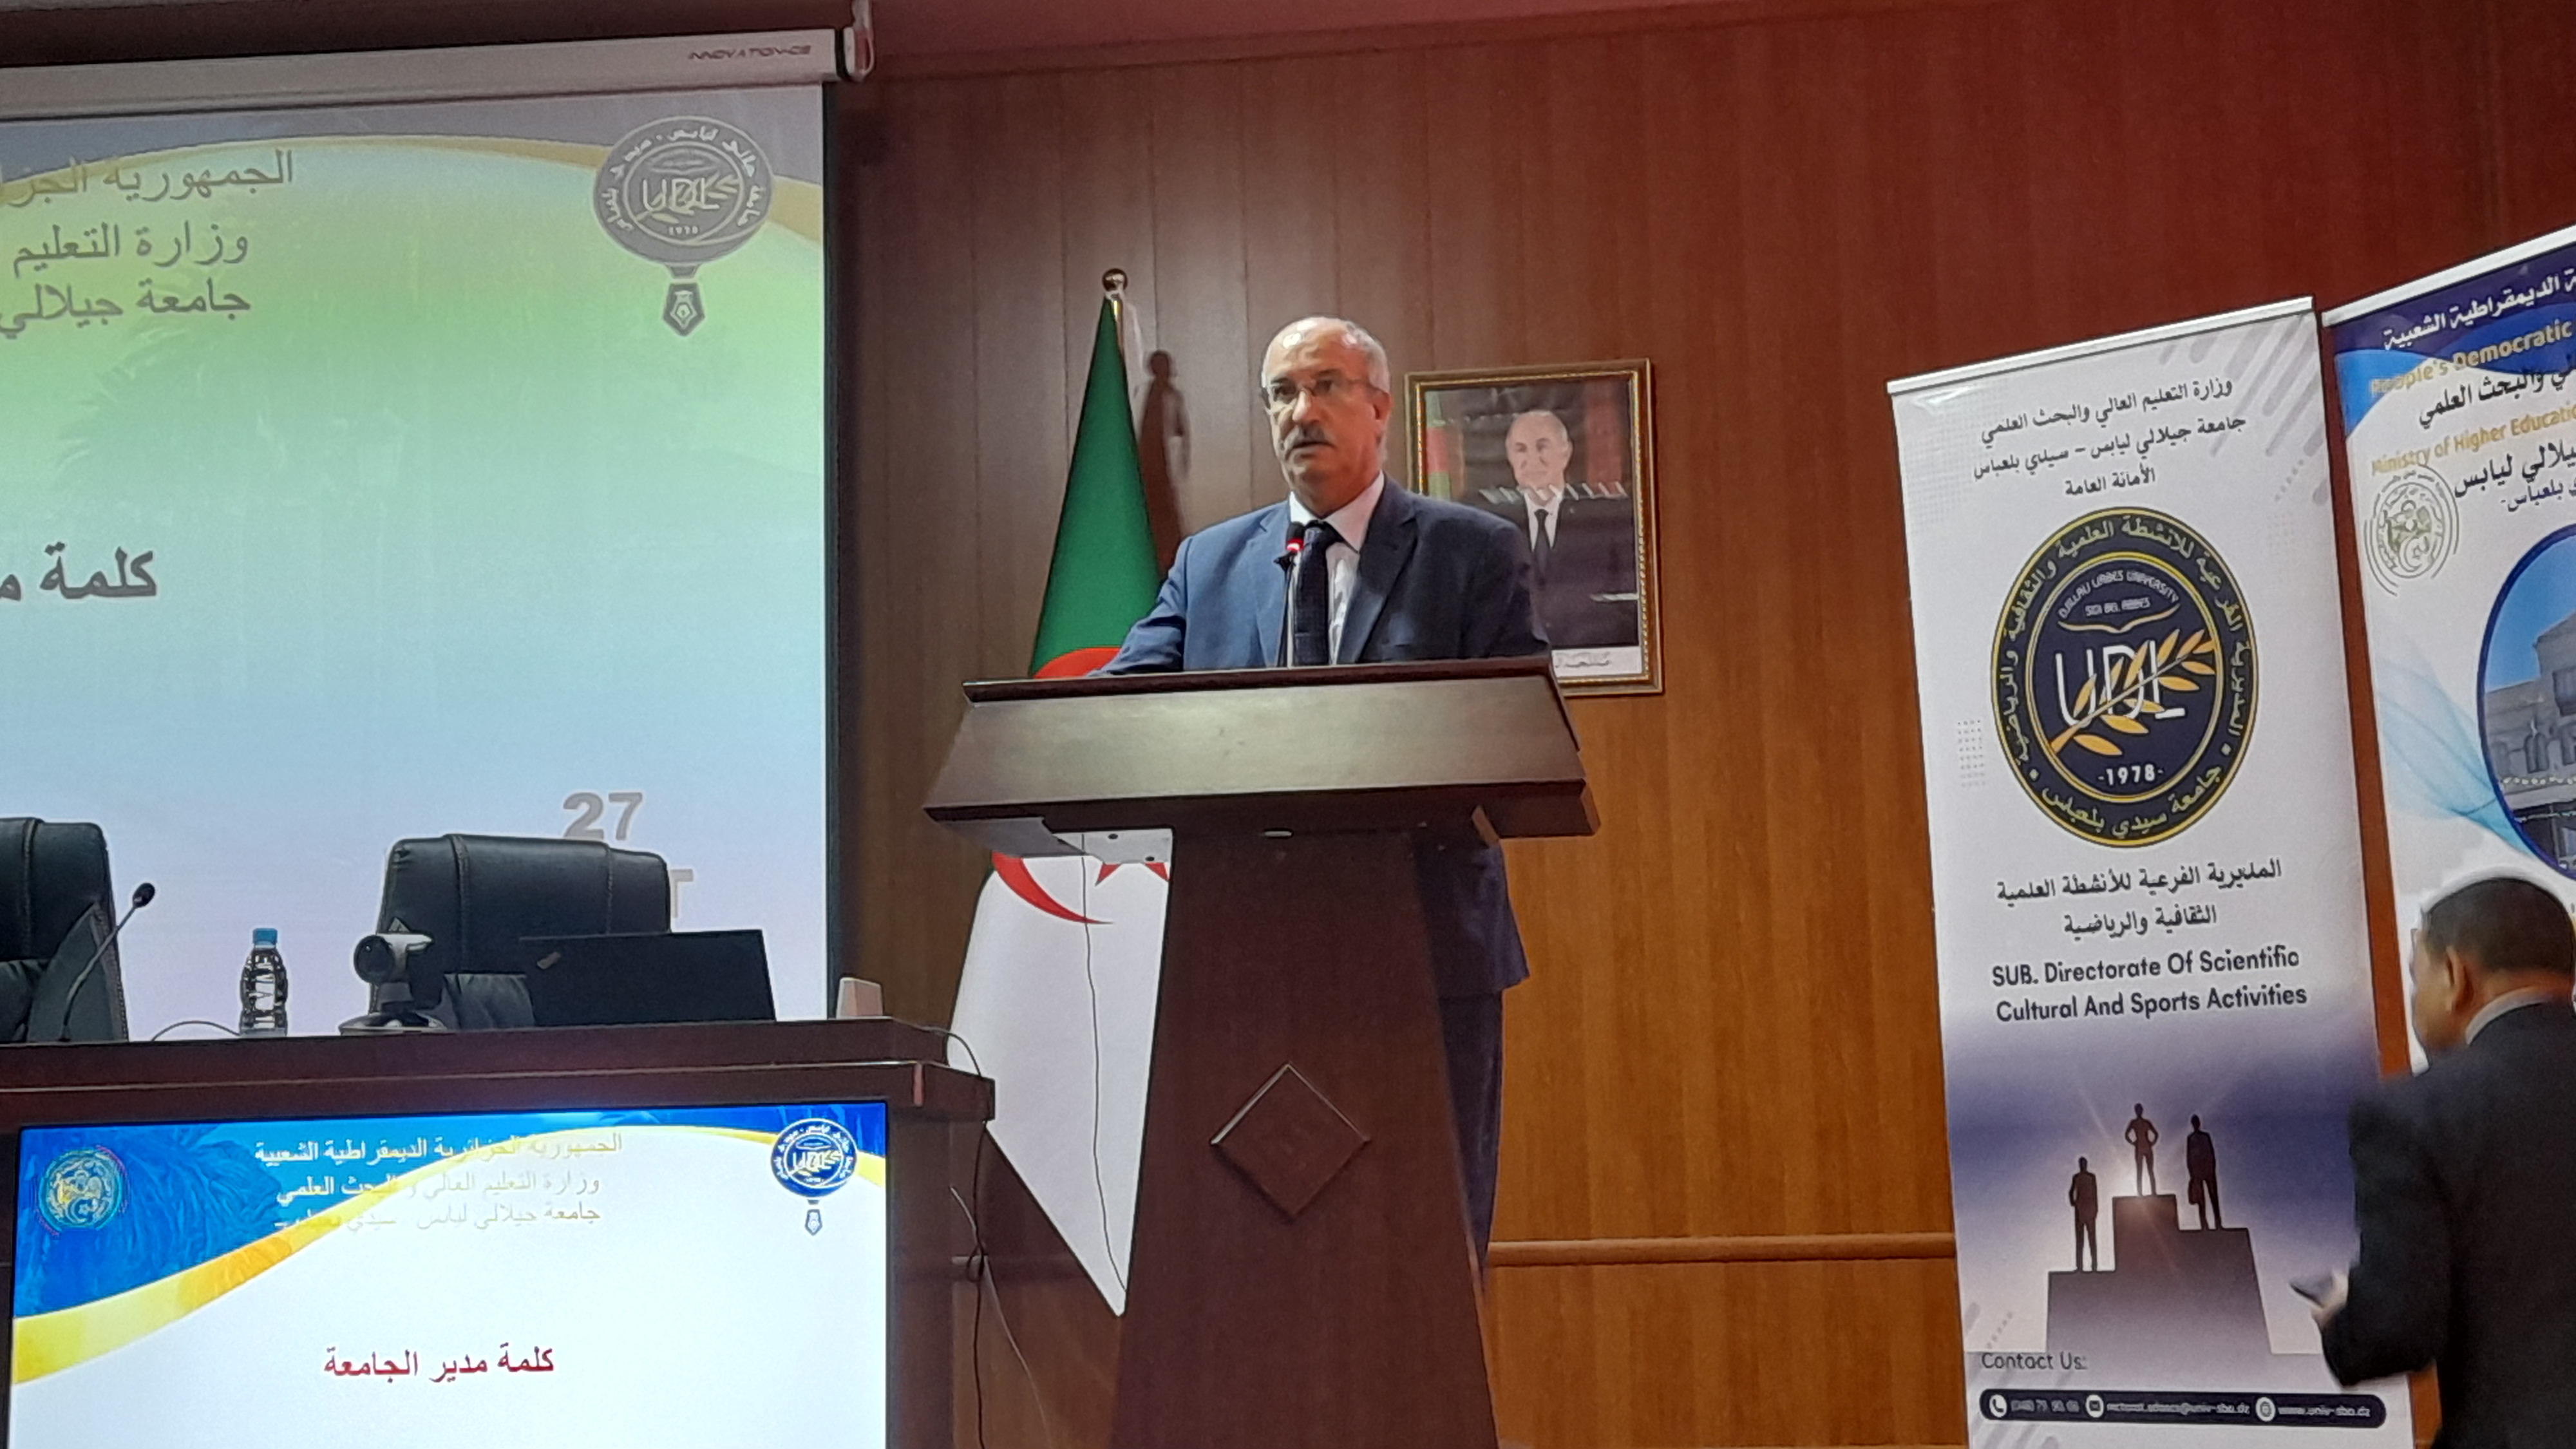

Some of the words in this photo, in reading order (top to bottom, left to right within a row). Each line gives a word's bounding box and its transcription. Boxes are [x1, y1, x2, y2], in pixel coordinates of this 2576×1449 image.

[13, 222, 120, 278] التعليم
[136, 220, 248, 267] وزارة
[0, 283, 124, 339] جيلالي
[136, 278, 251, 320] جامعة
[2448, 274, 2560, 329] الديمقراطية
[2383, 312, 2447, 351] الشعبية
[2452, 318, 2572, 371] Democratic
[2142, 383, 2188, 413] التعليم
[2192, 377, 2232, 401] وزارة
[2032, 404, 2090, 427] والبحث
[2096, 392, 2137, 428] العالي
[2419, 383, 2472, 430] العلمي
[1982, 412, 2028, 449] العلمي
[2197, 417, 2246, 433] جامعة
[2091, 432, 2130, 459] ليابس
[2136, 426, 2192, 460] جيلالي
[2434, 435, 2451, 458] of
[1974, 454, 2020, 480] بلعباس
[2025, 449, 2069, 476] سيدي
[2112, 462, 2156, 488] الأمانة
[2454, 453, 2512, 497] ليابس
[2065, 476, 2107, 496] العامة
[39, 541, 156, 599] كلمة
[2055, 639, 2186, 729] UDL
[2168, 766, 2222, 813] جامعة
[563, 791, 643, 840] 27
[2041, 787, 2105, 833] بلعباس
[2112, 812, 2168, 838] سيدي
[2062, 867, 2132, 895] للأنشطة
[2138, 864, 2201, 896] الفرعية
[2207, 857, 2282, 889] المديرية
[1997, 878, 2056, 907] العلمية
[2063, 909, 2148, 942] والرياضية
[2155, 903, 2217, 934] الثقافية
[1992, 963, 2039, 987] SUB.
[2043, 956, 2161, 983] Directorate
[2167, 949, 2193, 974] Of
[2199, 944, 2299, 973] Scientific
[1996, 994, 2078, 1023] Cultural
[2084, 991, 2125, 1017] And
[2130, 991, 2201, 1020] Sports
[2206, 982, 2307, 1009] Activities
[254, 1140, 319, 1167] الشعبية
[276, 1175, 335, 1208] العلمي
[544, 1201, 600, 1224] جامعة
[323, 1345, 419, 1383] الجامعة
[428, 1354, 488, 1383] مدير
[497, 1341, 554, 1372] كلمة
[1981, 1352, 2054, 1370] Contact
